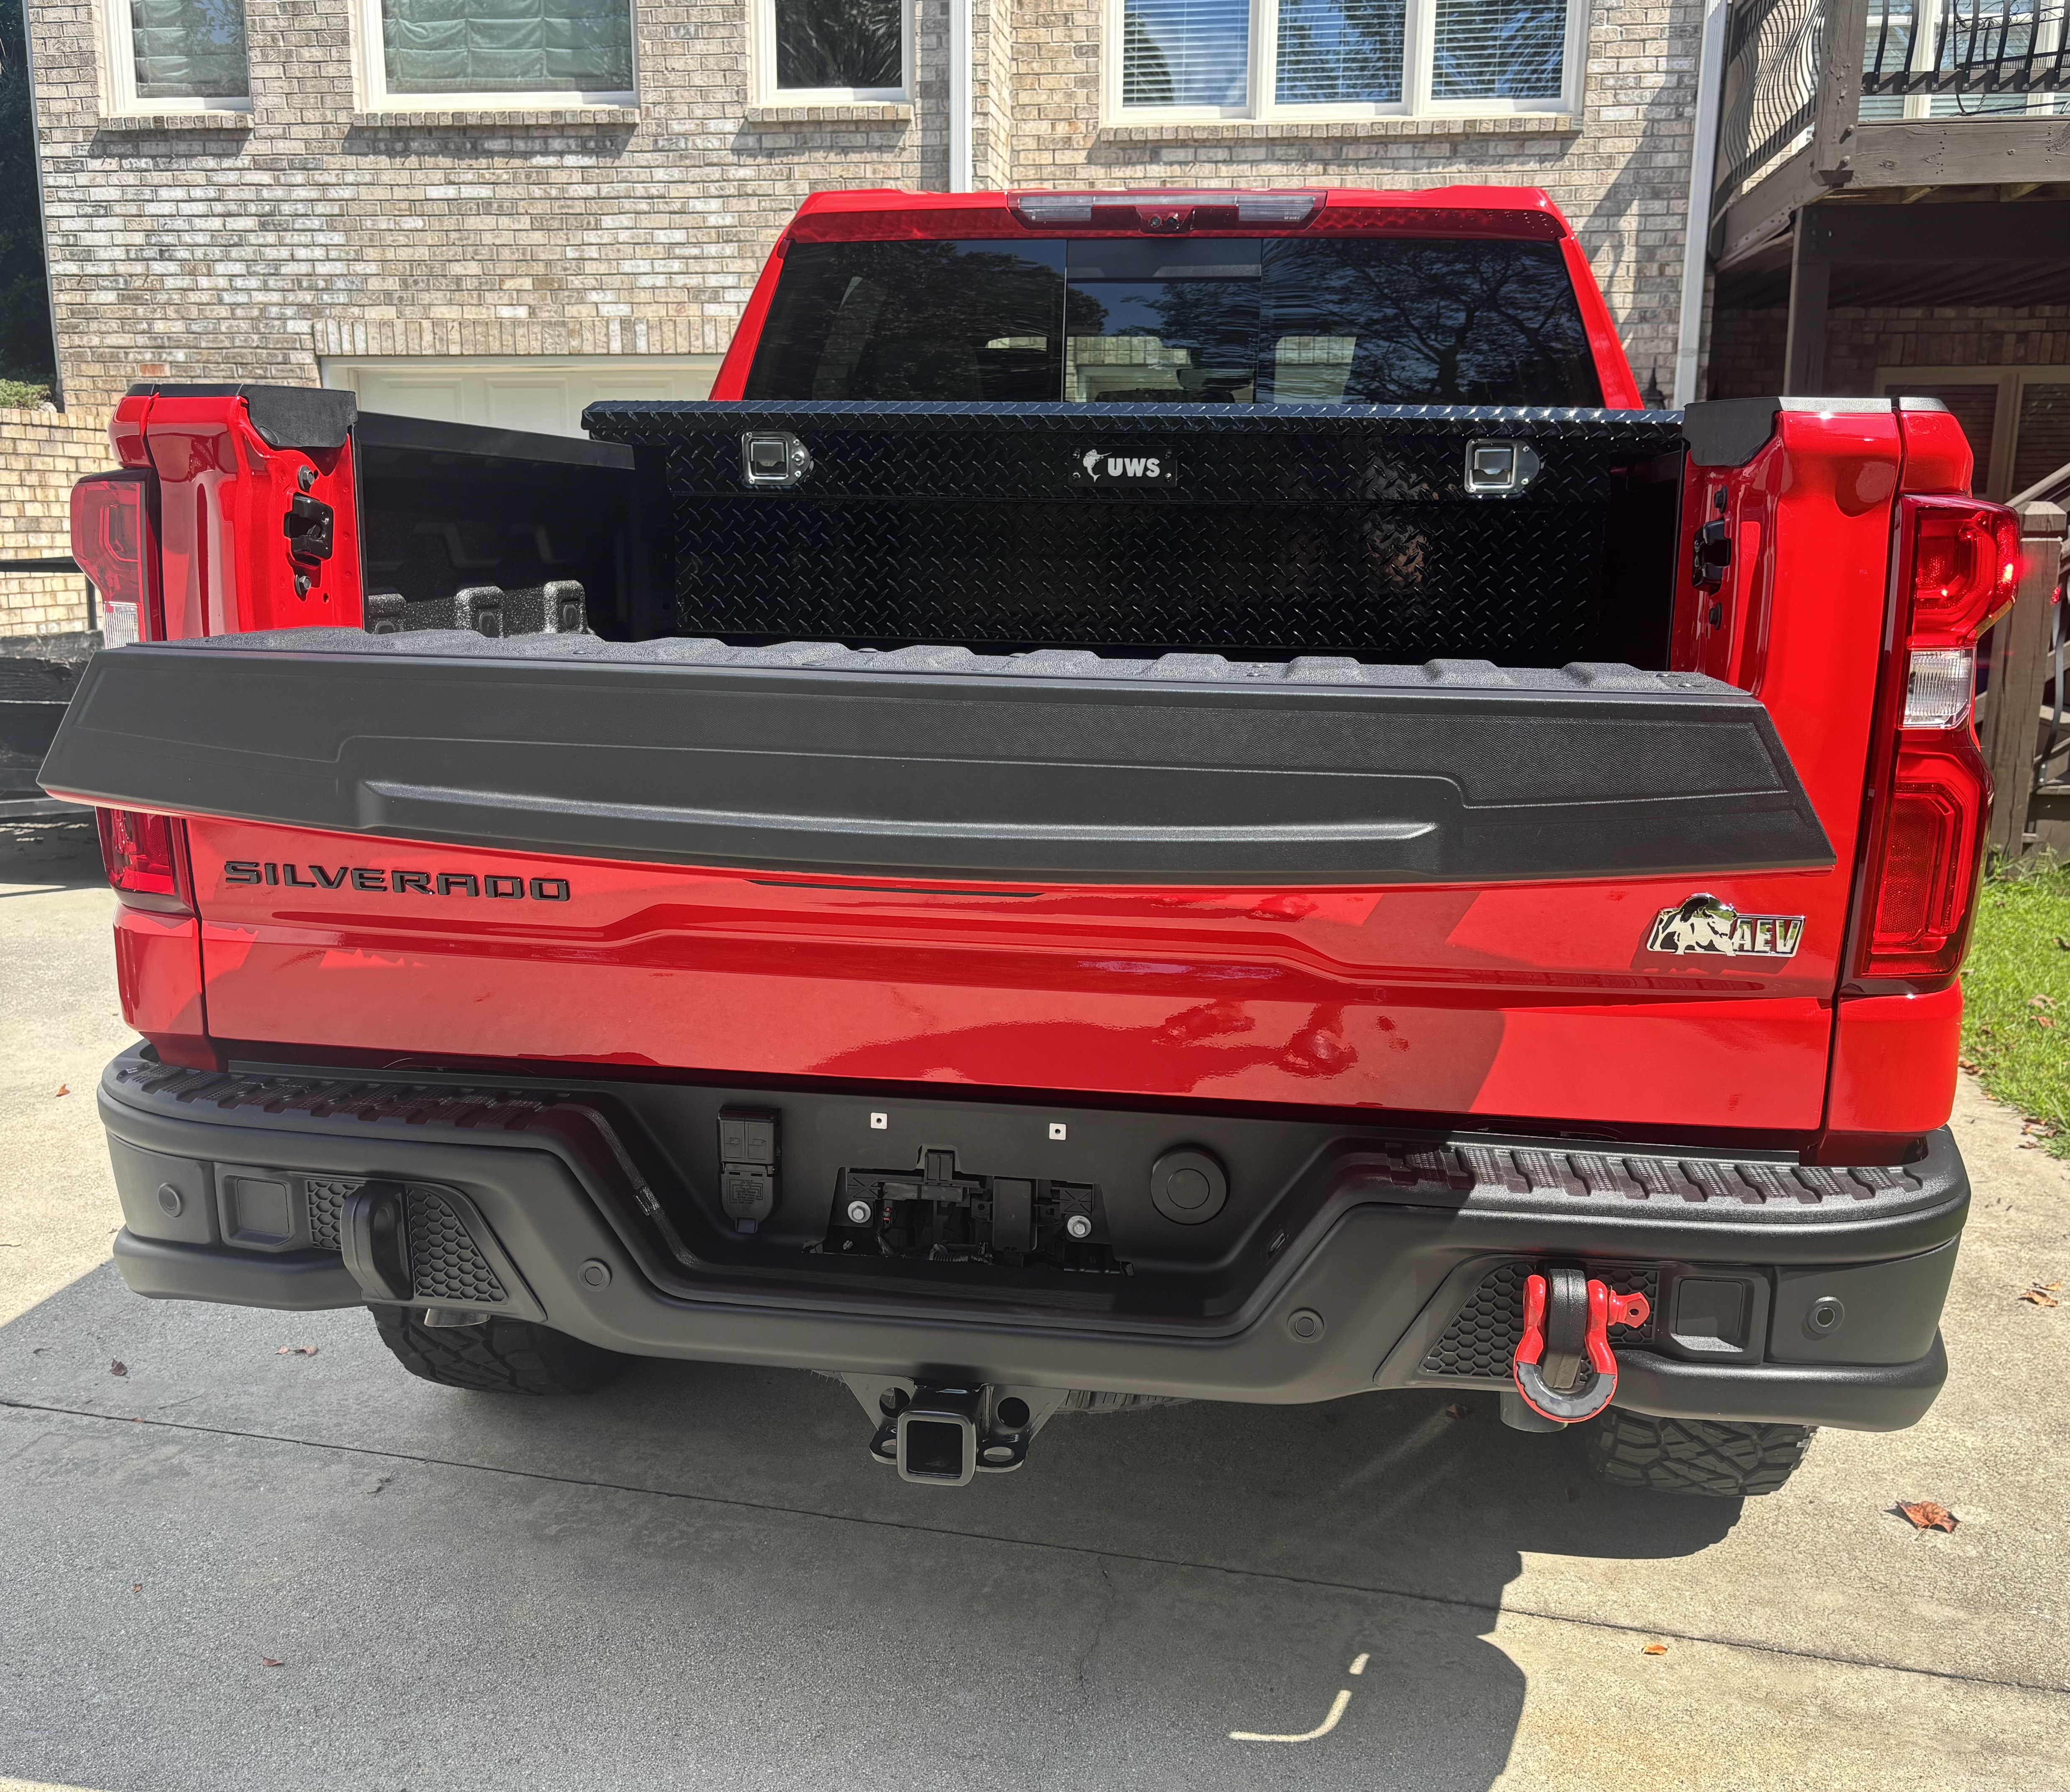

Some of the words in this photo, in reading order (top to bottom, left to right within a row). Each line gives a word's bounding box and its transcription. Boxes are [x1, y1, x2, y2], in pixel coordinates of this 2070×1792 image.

[1108, 458, 1160, 477] UWS
[225, 861, 570, 901] SILVERADO
[1733, 919, 1801, 952] AEV
